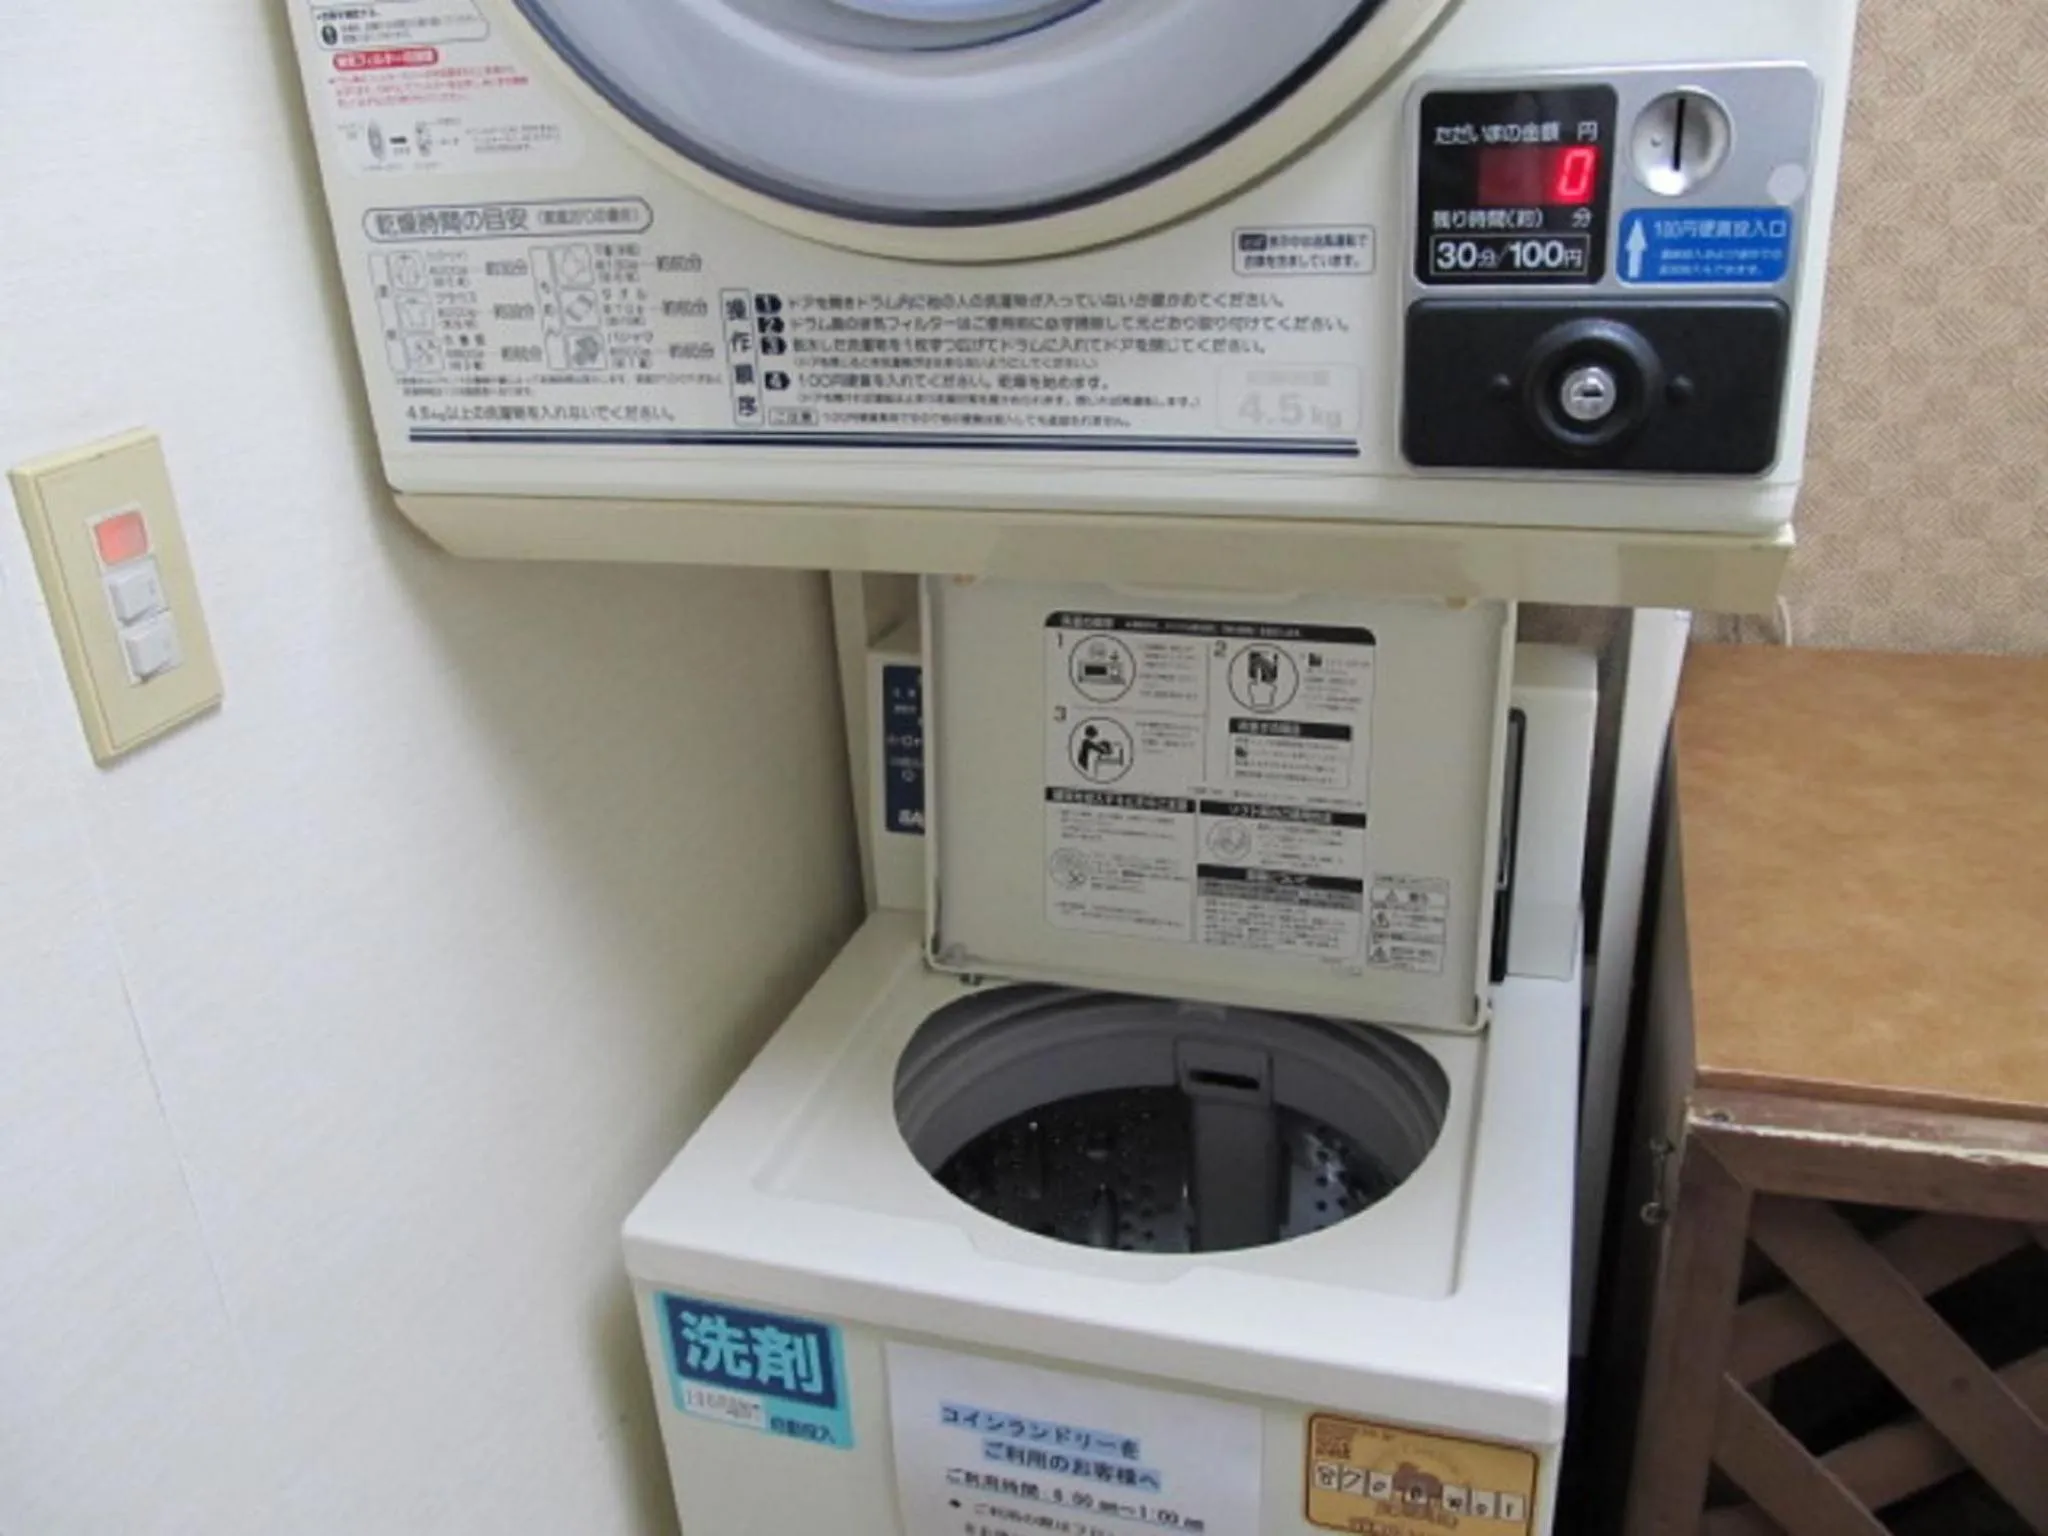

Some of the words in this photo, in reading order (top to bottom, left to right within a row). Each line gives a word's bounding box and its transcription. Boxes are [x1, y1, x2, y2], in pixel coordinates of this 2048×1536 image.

[1434, 121, 1561, 146] ただいまの金額
[1577, 120, 1598, 141] 円
[1559, 148, 1597, 198] 0
[1571, 207, 1593, 229] 分
[1213, 640, 1228, 659] 2
[679, 1310, 823, 1395] 洗剤
[941, 1405, 1140, 1461] コインランドリーを
[984, 1442, 1160, 1490] ご利用のお客様へ
